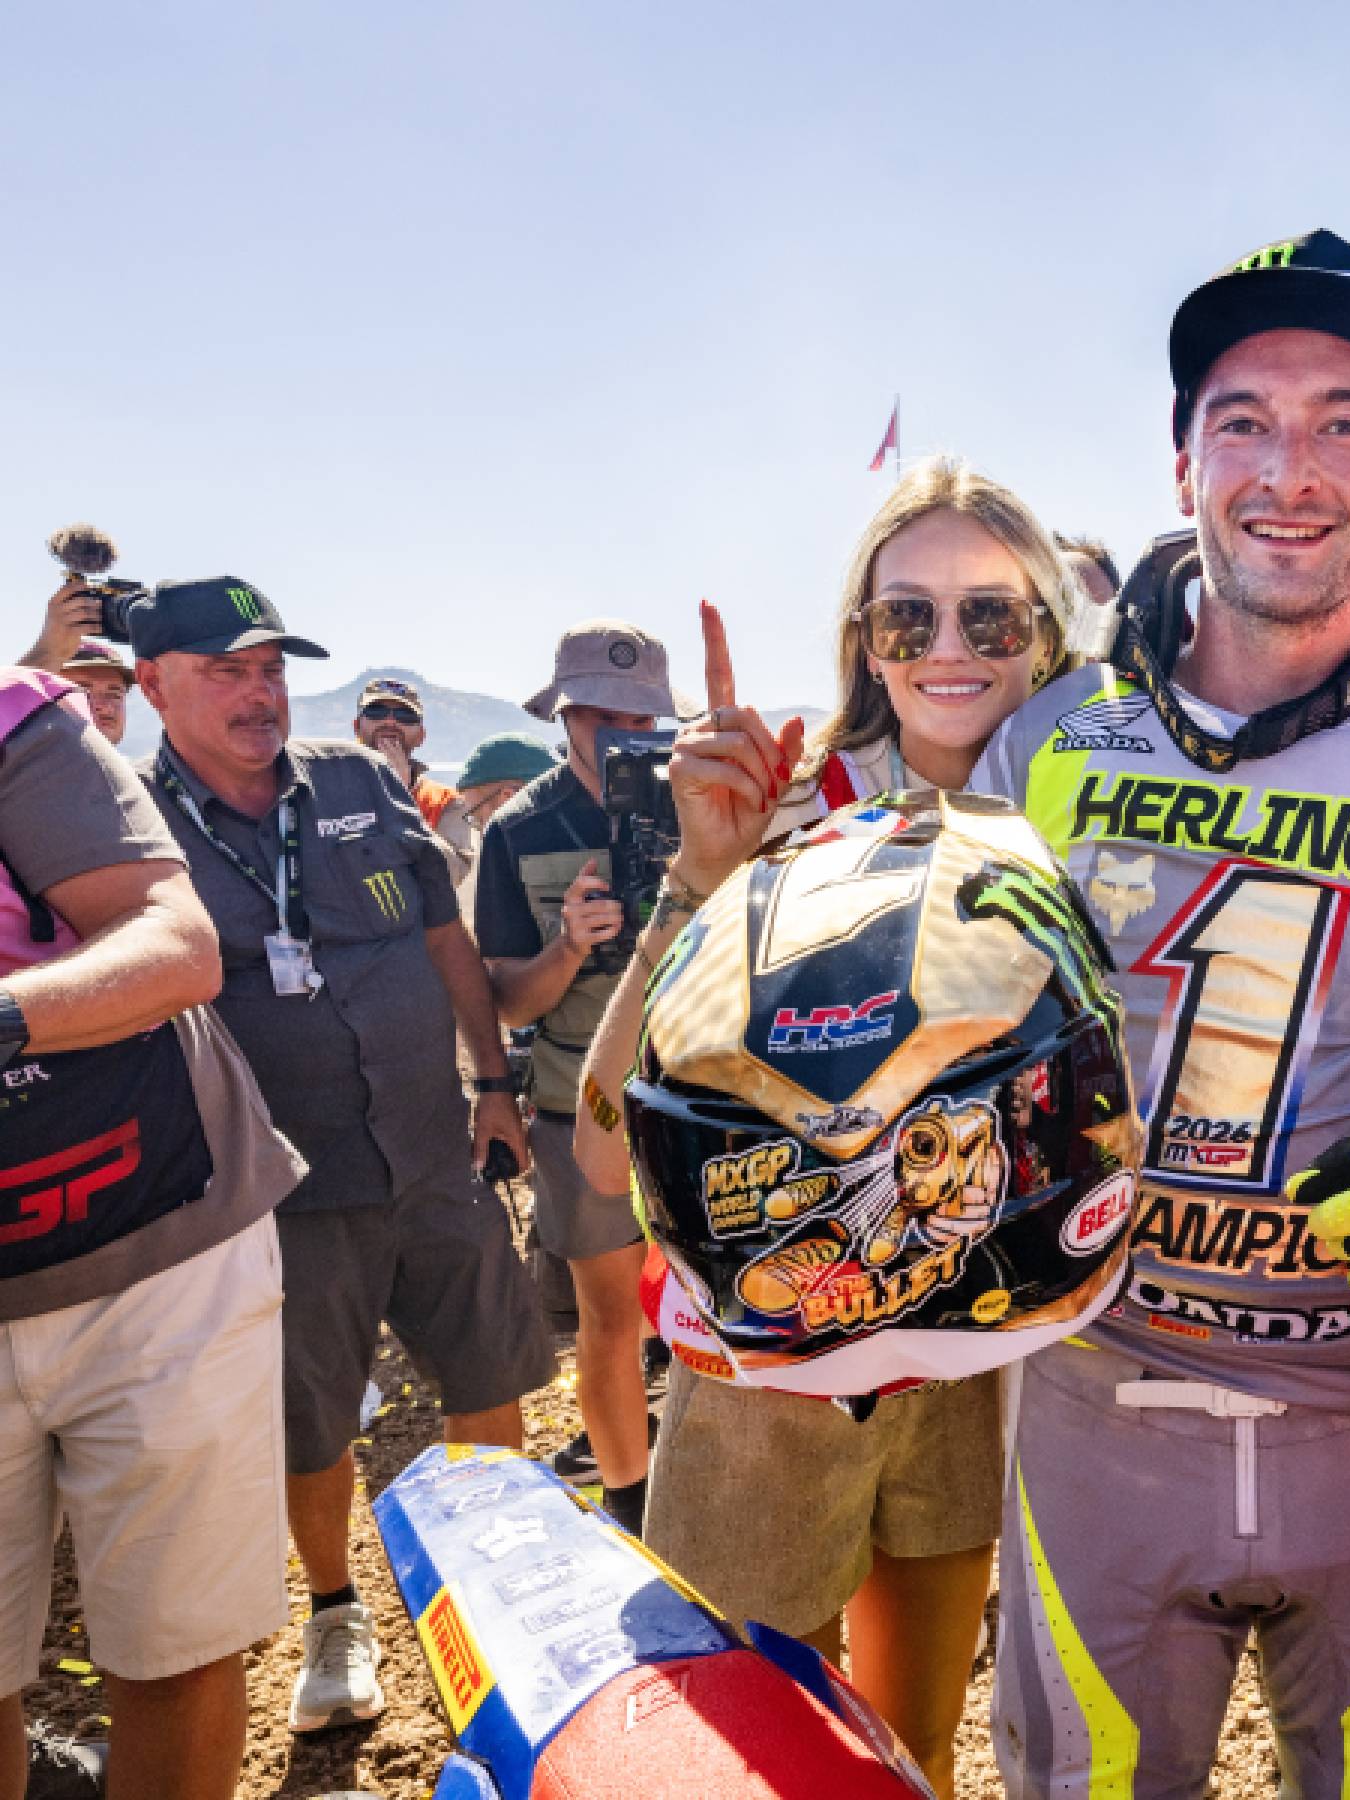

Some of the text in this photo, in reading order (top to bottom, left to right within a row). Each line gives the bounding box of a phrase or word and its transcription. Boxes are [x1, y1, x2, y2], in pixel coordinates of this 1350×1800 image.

[1053, 735, 1155, 754] HONDA
[767, 989, 900, 1044] HRC
[1168, 1115, 1253, 1144] 2026
[705, 1145, 792, 1198] MXGP
[1076, 1184, 1129, 1241] BELL
[1132, 1195, 1343, 1274] AMPI
[802, 1239, 963, 1329] BULLET
[428, 1591, 481, 1711] PIRELLI
